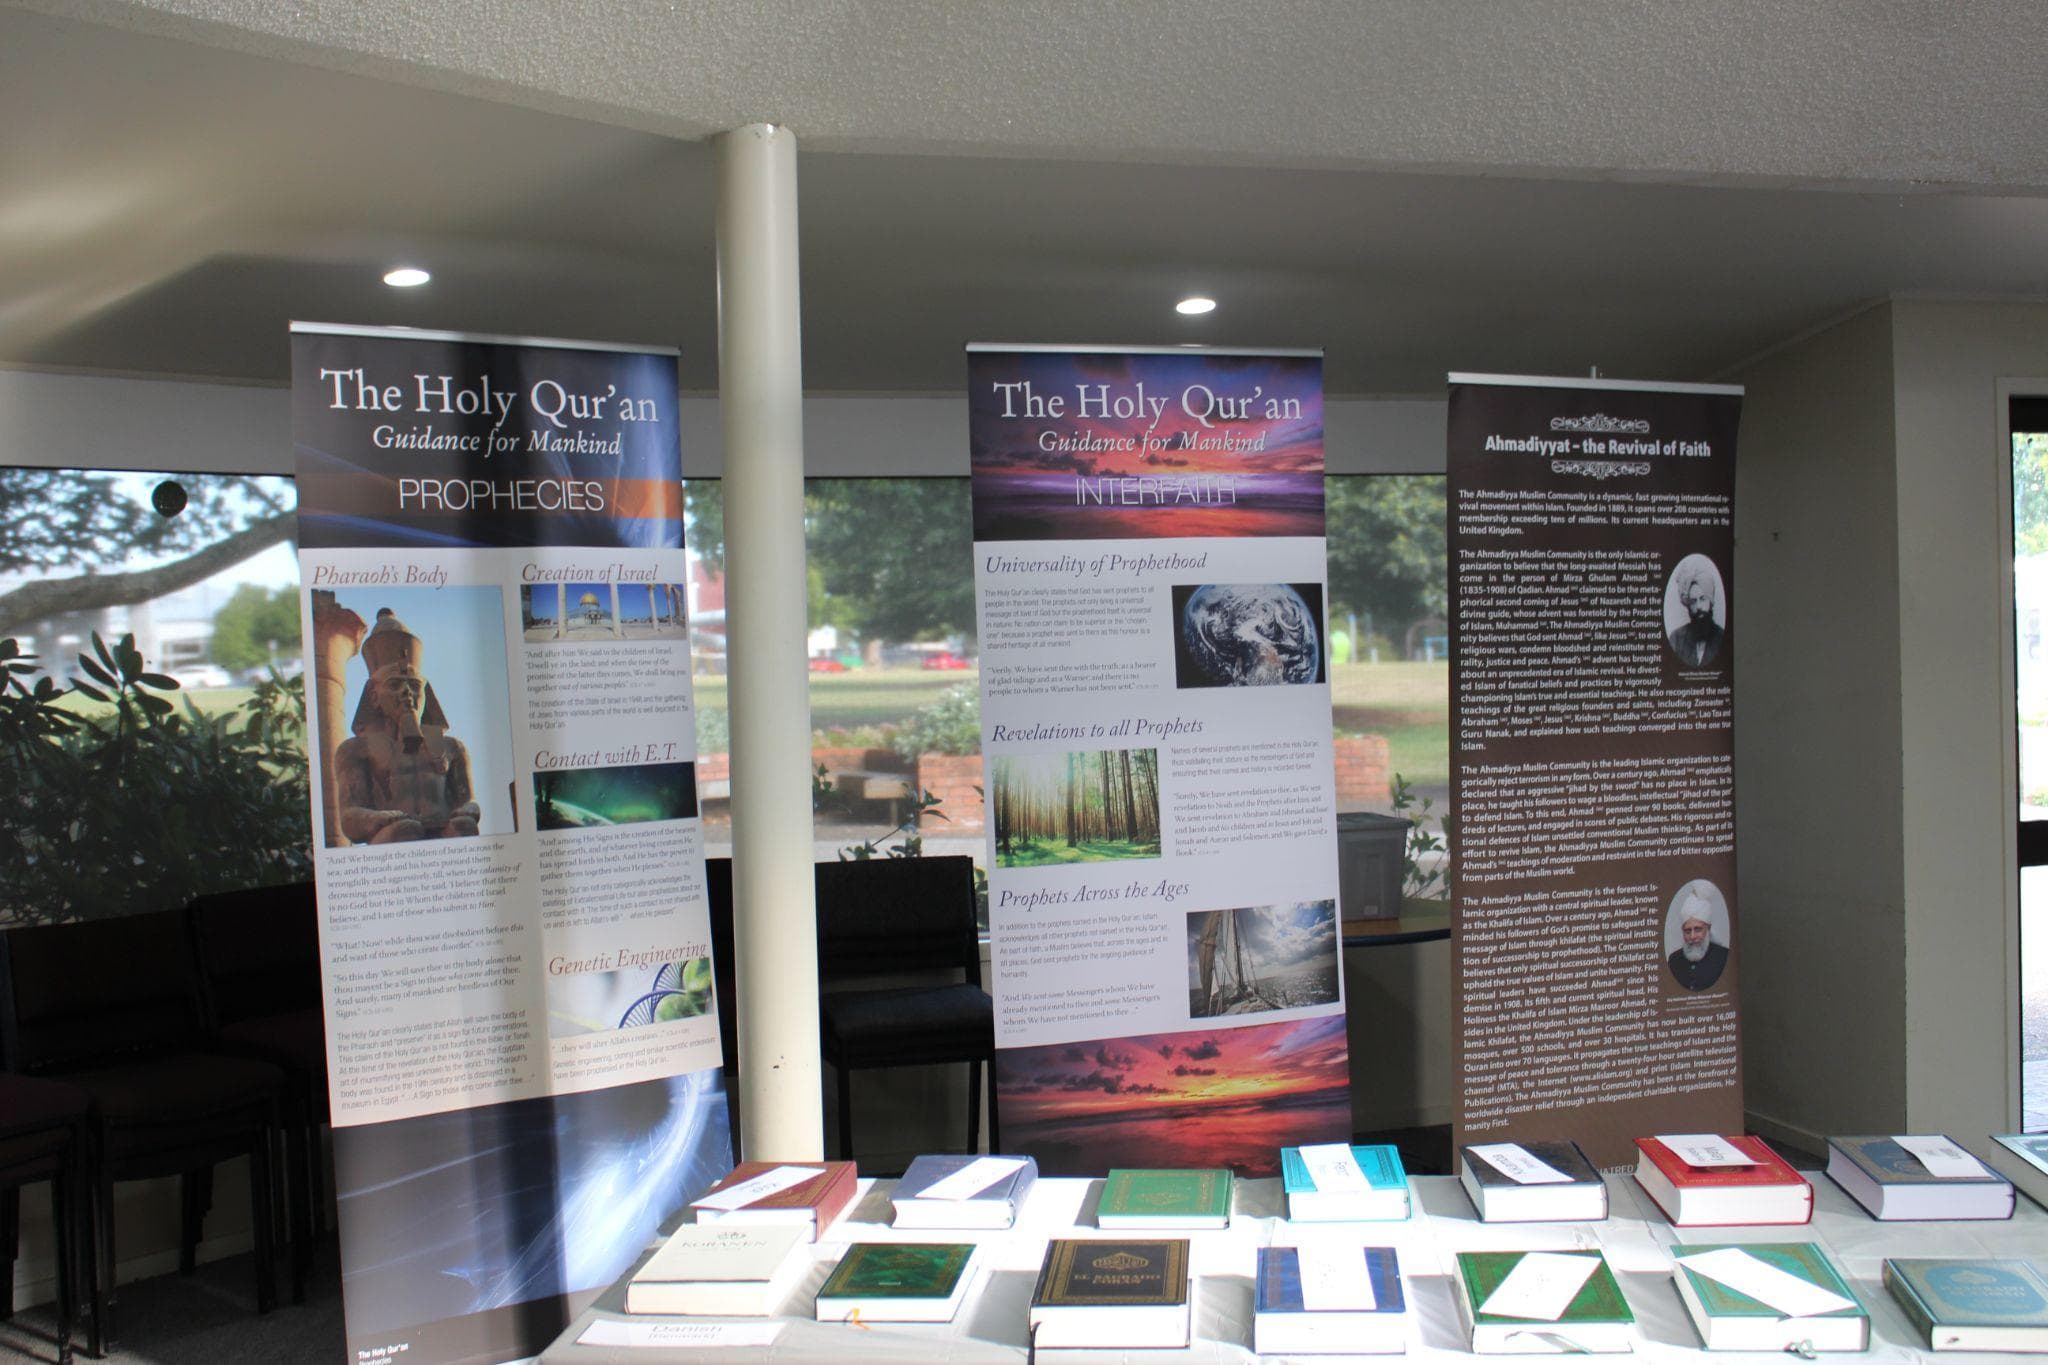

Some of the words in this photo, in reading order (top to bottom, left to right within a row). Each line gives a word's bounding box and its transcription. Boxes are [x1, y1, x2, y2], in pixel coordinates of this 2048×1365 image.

[320, 368, 402, 411] The
[413, 374, 517, 427] Holy
[530, 379, 660, 428] Qur'an
[993, 381, 1064, 419] The
[1075, 382, 1169, 430] Holy
[1181, 384, 1302, 429] Qur'an
[372, 424, 480, 452] Guidance
[484, 428, 520, 458] for
[526, 430, 622, 456] Mankind
[1038, 431, 1134, 453] Guidance
[1138, 431, 1171, 459] for
[1179, 431, 1266, 452] Mankind
[1485, 436, 1570, 456] Ahmadiyyat
[1582, 439, 1606, 454] the
[1608, 439, 1661, 455] Revival
[1663, 441, 1676, 456] of
[1679, 441, 1711, 457] Faith
[399, 479, 606, 511] PROPHECIES
[1074, 477, 1238, 505] INTERFAITH
[1460, 490, 1475, 499] The
[1476, 490, 1518, 502] Ahmadiyya
[1519, 490, 1547, 500] Muslim
[1547, 490, 1588, 502] Community
[1589, 491, 1595, 500] is
[1602, 491, 1634, 503] dynamic,
[1635, 492, 1650, 501] fast
[1651, 492, 1680, 504] growing
[1681, 492, 1722, 502] international
[1459, 501, 1479, 511] vival
[1480, 502, 1520, 511] movement
[1521, 502, 1545, 512] within
[1545, 503, 1565, 512] Islam.
[1566, 503, 1598, 512] Founded
[1599, 504, 1607, 513] in
[1608, 504, 1627, 515] 1889,
[1627, 504, 1634, 513] it
[1635, 506, 1656, 515] spans
[1688, 505, 1718, 514] countries
[1459, 514, 1509, 526] membership
[1511, 514, 1548, 526] exceeding
[1550, 515, 1566, 524] tens
[1568, 515, 1576, 524] of
[1578, 515, 1608, 524] millions.
[1611, 515, 1620, 524] Its
[1623, 515, 1649, 524] current
[1652, 515, 1698, 527] headquarters
[1459, 525, 1487, 534] United
[1488, 525, 1523, 537] Kingdom.
[312, 565, 399, 584] Pharaoh's
[405, 566, 448, 590] Body
[522, 563, 594, 582] Creation
[597, 563, 618, 585] of
[616, 564, 658, 582] Israel
[986, 556, 1086, 577] Universality
[1090, 554, 1110, 577] of
[1110, 552, 1208, 578] Prophethood
[1460, 608, 1486, 618] divine
[1488, 608, 1512, 620] guide,
[1513, 608, 1536, 618] whose
[1538, 608, 1562, 617] advent
[1578, 607, 1608, 617] foretold
[1608, 607, 1618, 619] by
[1619, 607, 1631, 616] the
[1632, 606, 1662, 618] Prophet
[991, 722, 1086, 742] Revelations
[1091, 724, 1105, 737] to
[1109, 718, 1130, 735] all
[1134, 716, 1204, 742] Prophets
[534, 748, 589, 769] Contact
[605, 744, 640, 764] with
[646, 742, 677, 762] E.T.
[1462, 871, 1483, 882] from
[1484, 870, 1504, 883] parts
[1504, 869, 1513, 879] of
[1513, 869, 1525, 879] the
[1526, 867, 1552, 878] Muslim
[1553, 865, 1575, 876] world.
[998, 888, 1069, 912] Prophets
[1073, 883, 1119, 902] Across
[1125, 881, 1149, 900] the
[1151, 878, 1190, 906] Ages
[549, 956, 602, 976] Genetic
[617, 940, 710, 973] Engineering
[1464, 1049, 1500, 1062] mosques,
[1502, 1047, 1518, 1056] over
[1521, 1043, 1535, 1054] 500
[1536, 1039, 1566, 1054] schools,
[1568, 1038, 1583, 1048] and
[1584, 1038, 1601, 1046] over
[1603, 1034, 1613, 1044] 30
[1614, 1031, 1647, 1046] hospitals.
[1648, 1030, 1655, 1040] It
[1656, 1028, 1669, 1039] has
[1671, 1025, 1706, 1038] translated
[1708, 1023, 1721, 1034] the
[1722, 1022, 1736, 1035] Holy
[1464, 1119, 1491, 1134] manity
[1492, 1117, 1509, 1128] First.
[652, 1324, 722, 1333] Danish
[358, 1350, 371, 1359] The
